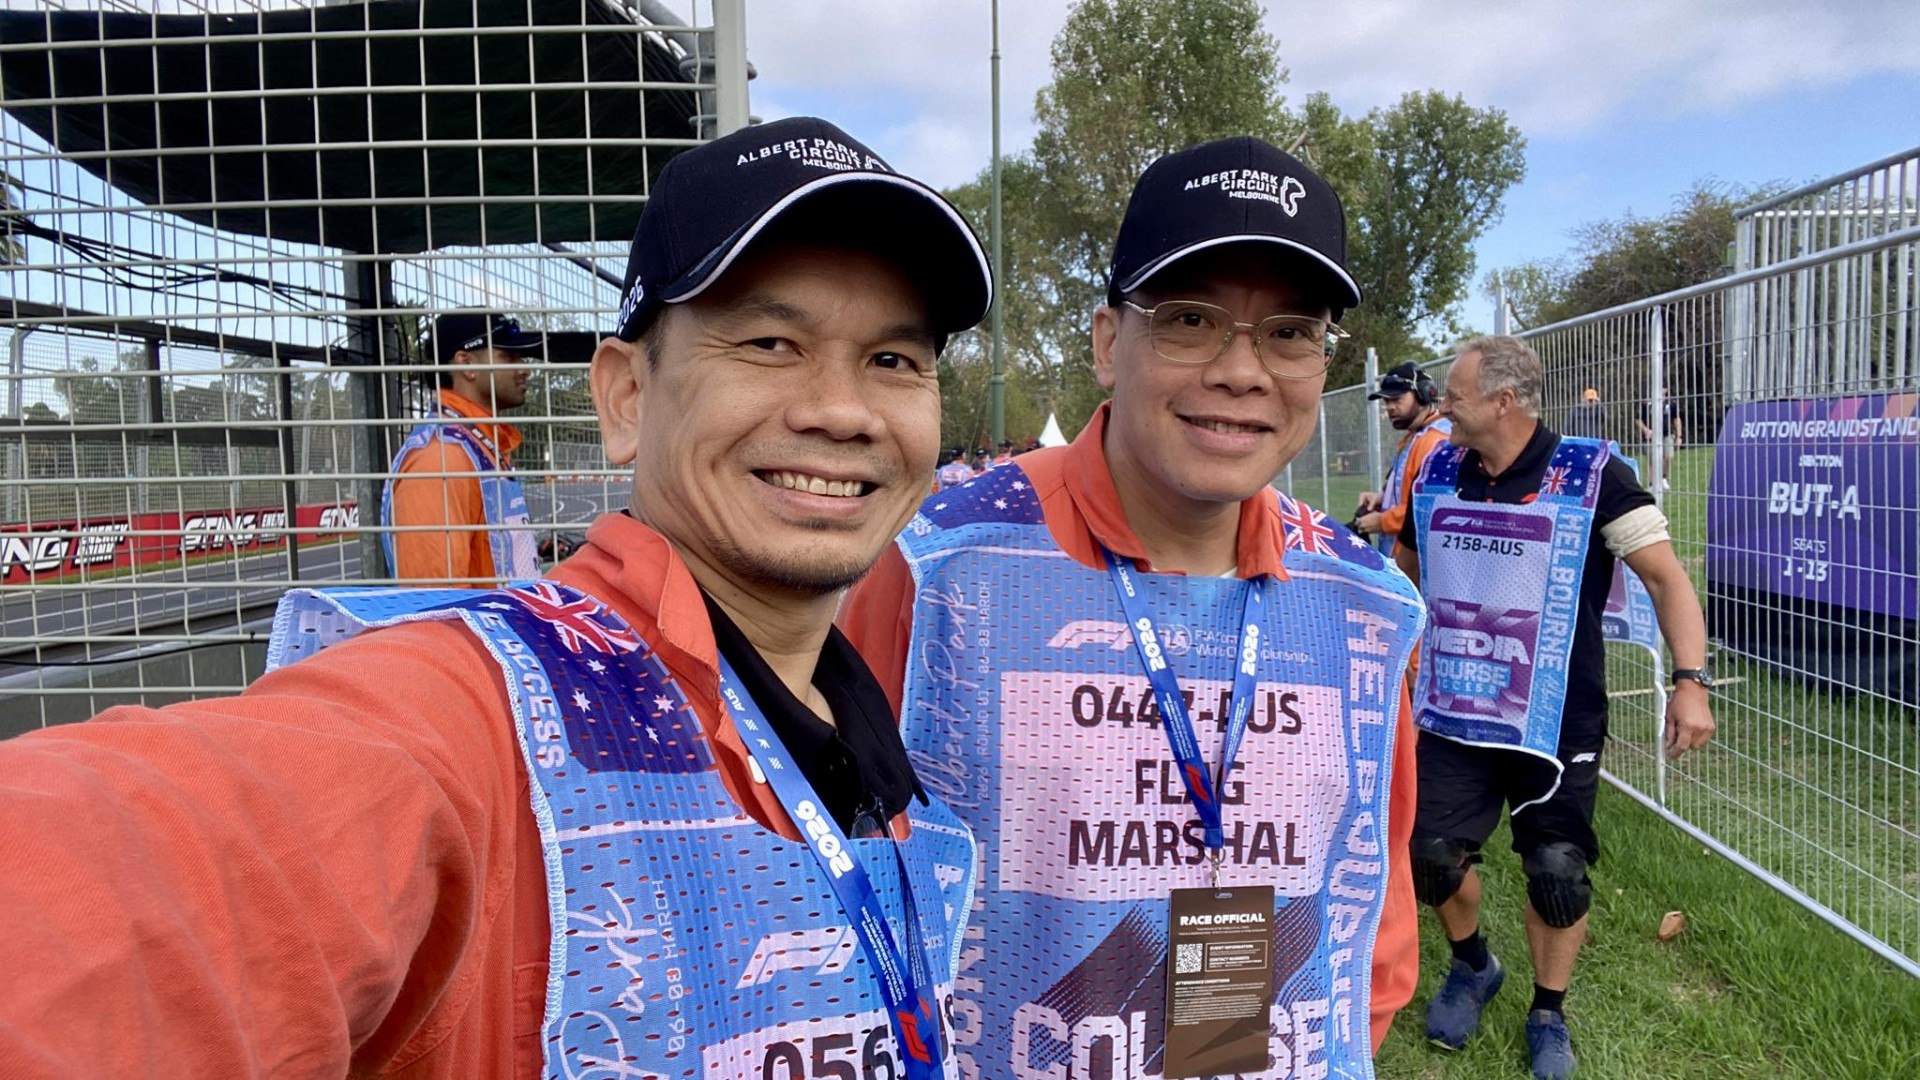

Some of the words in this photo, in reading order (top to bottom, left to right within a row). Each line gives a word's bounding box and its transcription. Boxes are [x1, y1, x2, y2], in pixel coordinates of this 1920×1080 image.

[737, 138, 807, 165] ALBERT
[814, 138, 858, 161] PARK
[789, 148, 861, 168] CIRCUIT
[803, 158, 857, 170] MELBOU
[1184, 170, 1238, 190] ALBERT
[1242, 169, 1278, 185] PARK
[1221, 179, 1278, 194] CIRCUIT
[1229, 191, 1279, 203] MELBOURNE
[618, 275, 644, 336] 2026
[1741, 421, 1802, 438] BUTTON
[1799, 454, 1842, 467] SECTION
[1769, 481, 1861, 520] BUT-A
[180, 513, 257, 551] STING
[1442, 535, 1524, 556] 2158-AUS
[1793, 538, 1826, 553] SEATS
[1135, 617, 1167, 672] 2026
[1241, 623, 1260, 676] 2026
[724, 688, 745, 711] AUS
[1442, 680, 1497, 694] CCESS
[497, 638, 566, 768] ACCESS
[1072, 684, 1302, 735] 044-US
[1135, 758, 1245, 806] FLG
[794, 800, 855, 879] 2026
[1068, 819, 1306, 867] MARSHAL
[1180, 915, 1212, 926] RACE
[1213, 913, 1266, 924] OFFICIAL
[1012, 997, 1329, 1080] COUSE
